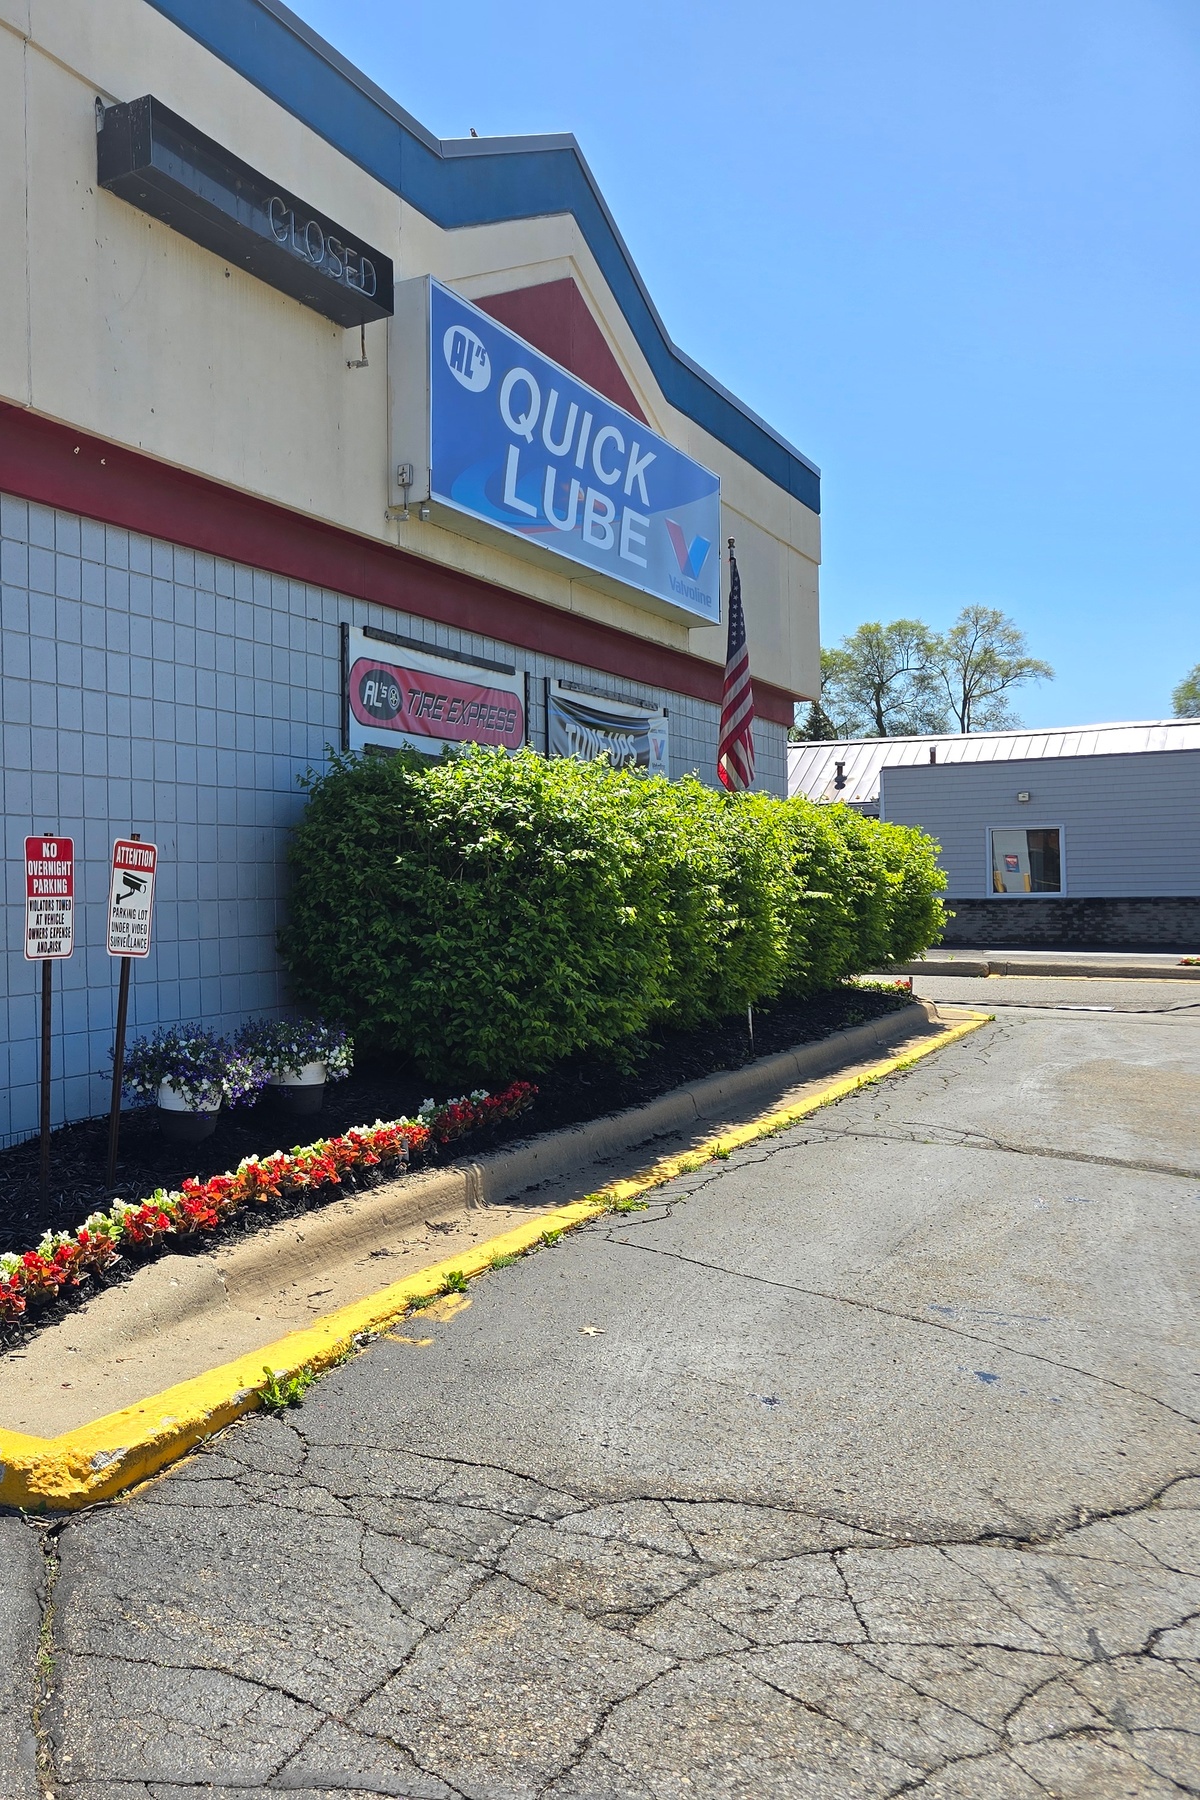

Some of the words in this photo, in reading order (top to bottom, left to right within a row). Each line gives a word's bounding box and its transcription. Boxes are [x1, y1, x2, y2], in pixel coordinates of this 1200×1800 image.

[269, 197, 377, 297] CLOSED
[499, 367, 658, 507] QUICK
[503, 444, 651, 569] LUBE
[668, 573, 713, 608] Valvoline
[407, 688, 449, 722] TIRE
[446, 697, 517, 735] EXPRESS
[42, 842, 58, 858] NO
[116, 845, 155, 868] ATTENTION
[27, 860, 72, 876] OVERNIGHT
[33, 878, 68, 894] PARKING
[29, 899, 55, 912] VIOLATORS
[55, 899, 71, 911] TOWED
[112, 906, 137, 920] PARKING
[137, 908, 148, 921] LOT
[35, 913, 43, 925] AT
[44, 913, 65, 925] VEHICLE
[28, 927, 49, 940] OWNERS
[49, 926, 71, 939] EXPENSE
[111, 921, 130, 933] UNDER
[131, 923, 148, 935] VIDEO
[36, 941, 48, 954] AND
[48, 940, 62, 953] RISK
[110, 935, 147, 949] SURVEILLANCE
